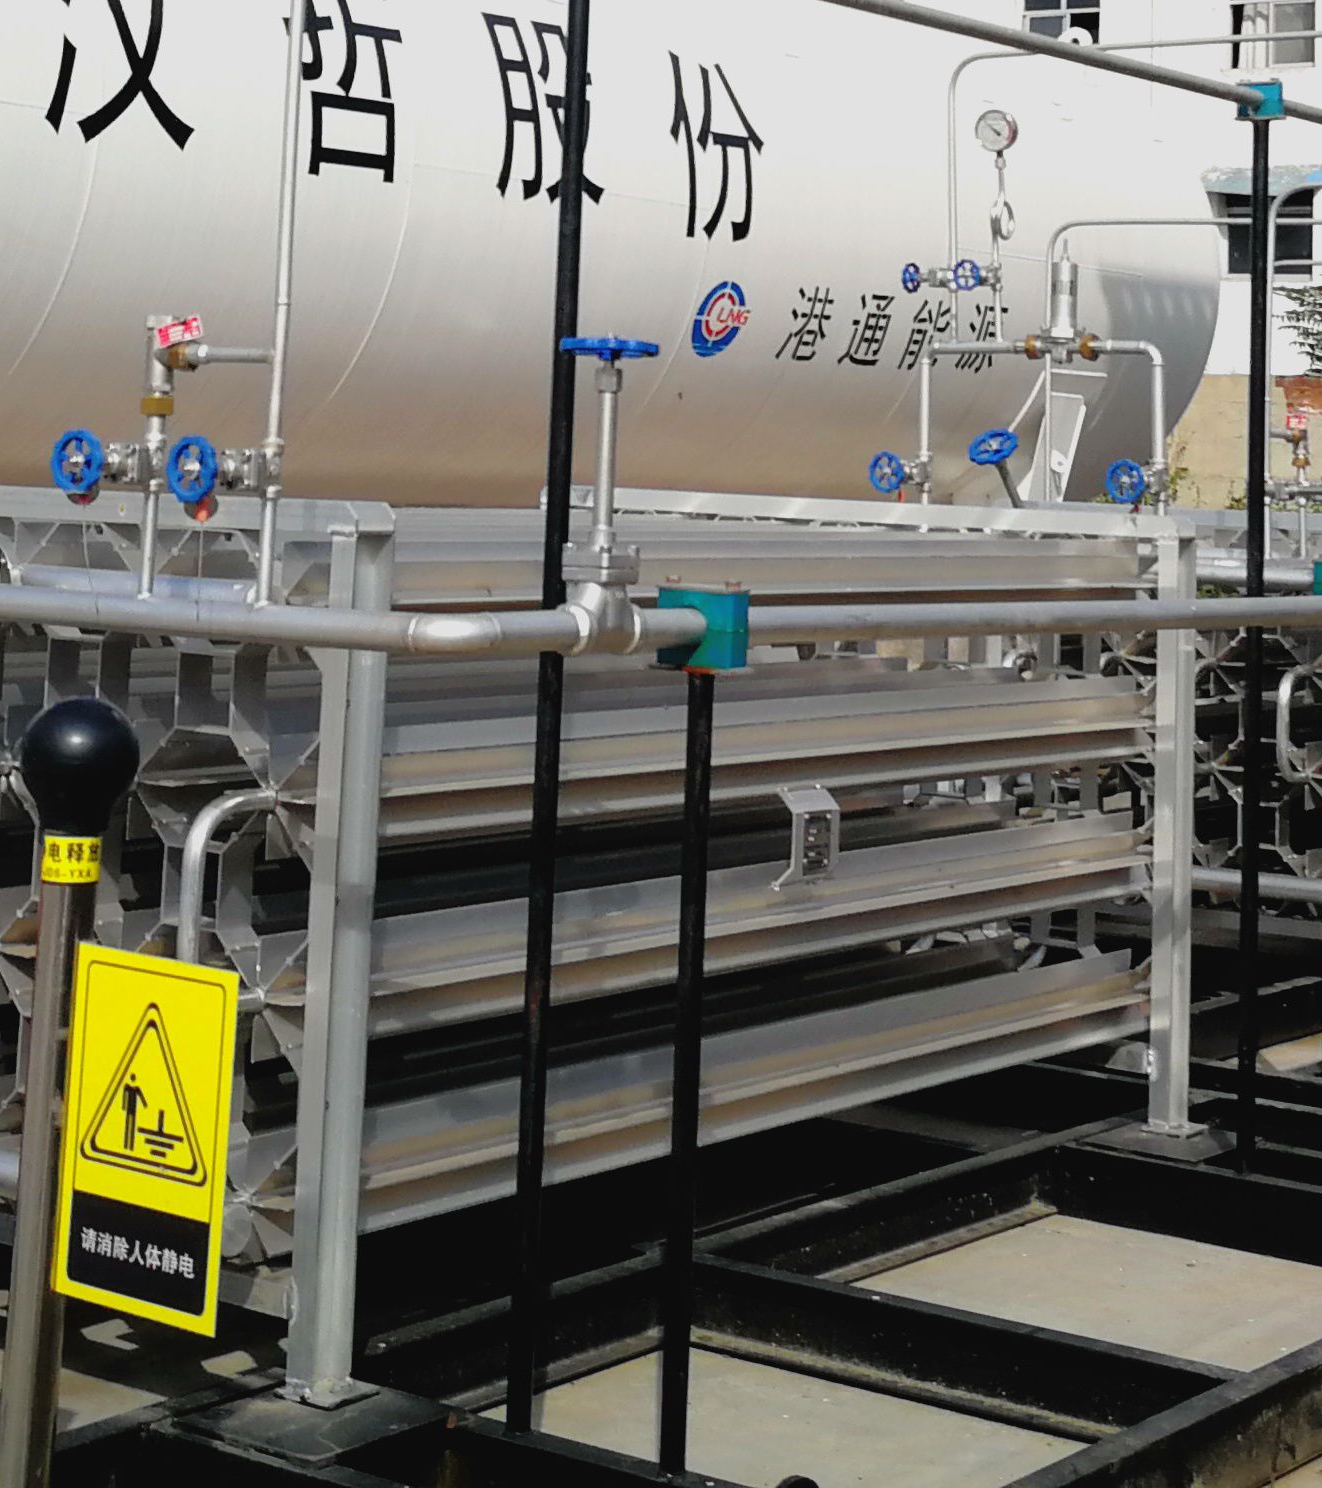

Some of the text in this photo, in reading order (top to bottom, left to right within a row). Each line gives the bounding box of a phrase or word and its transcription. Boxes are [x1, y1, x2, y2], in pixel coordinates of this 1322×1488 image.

[716, 307, 751, 326] LNG
[80, 1226, 195, 1279] 请消除人体静电
